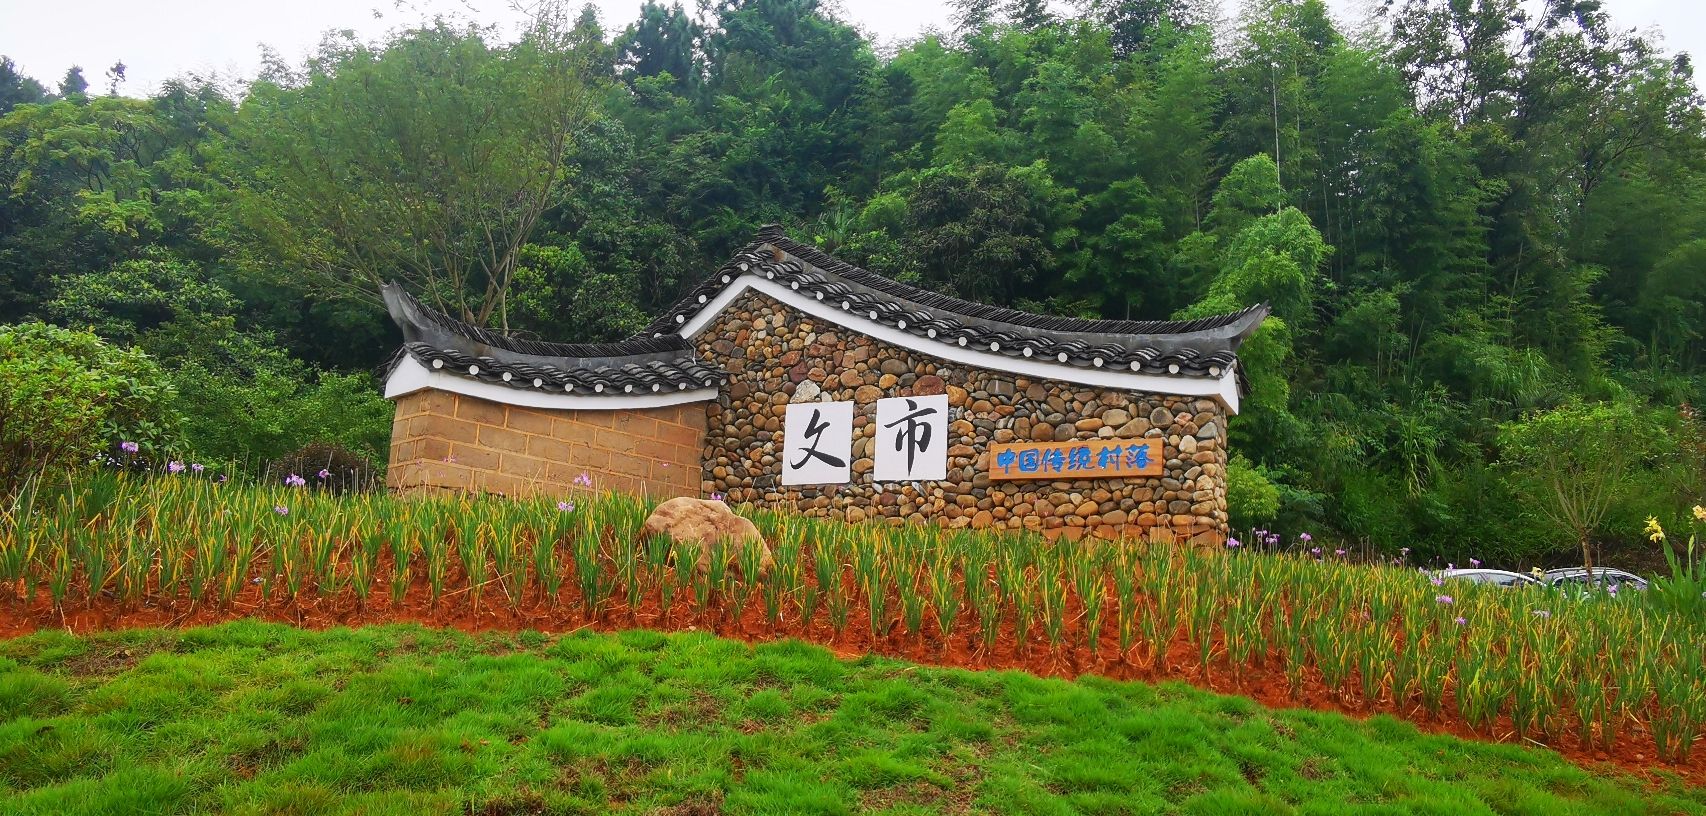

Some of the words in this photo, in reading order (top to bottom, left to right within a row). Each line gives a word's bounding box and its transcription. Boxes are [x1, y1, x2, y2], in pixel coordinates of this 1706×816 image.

[997, 443, 1154, 475] 中国传统村落
